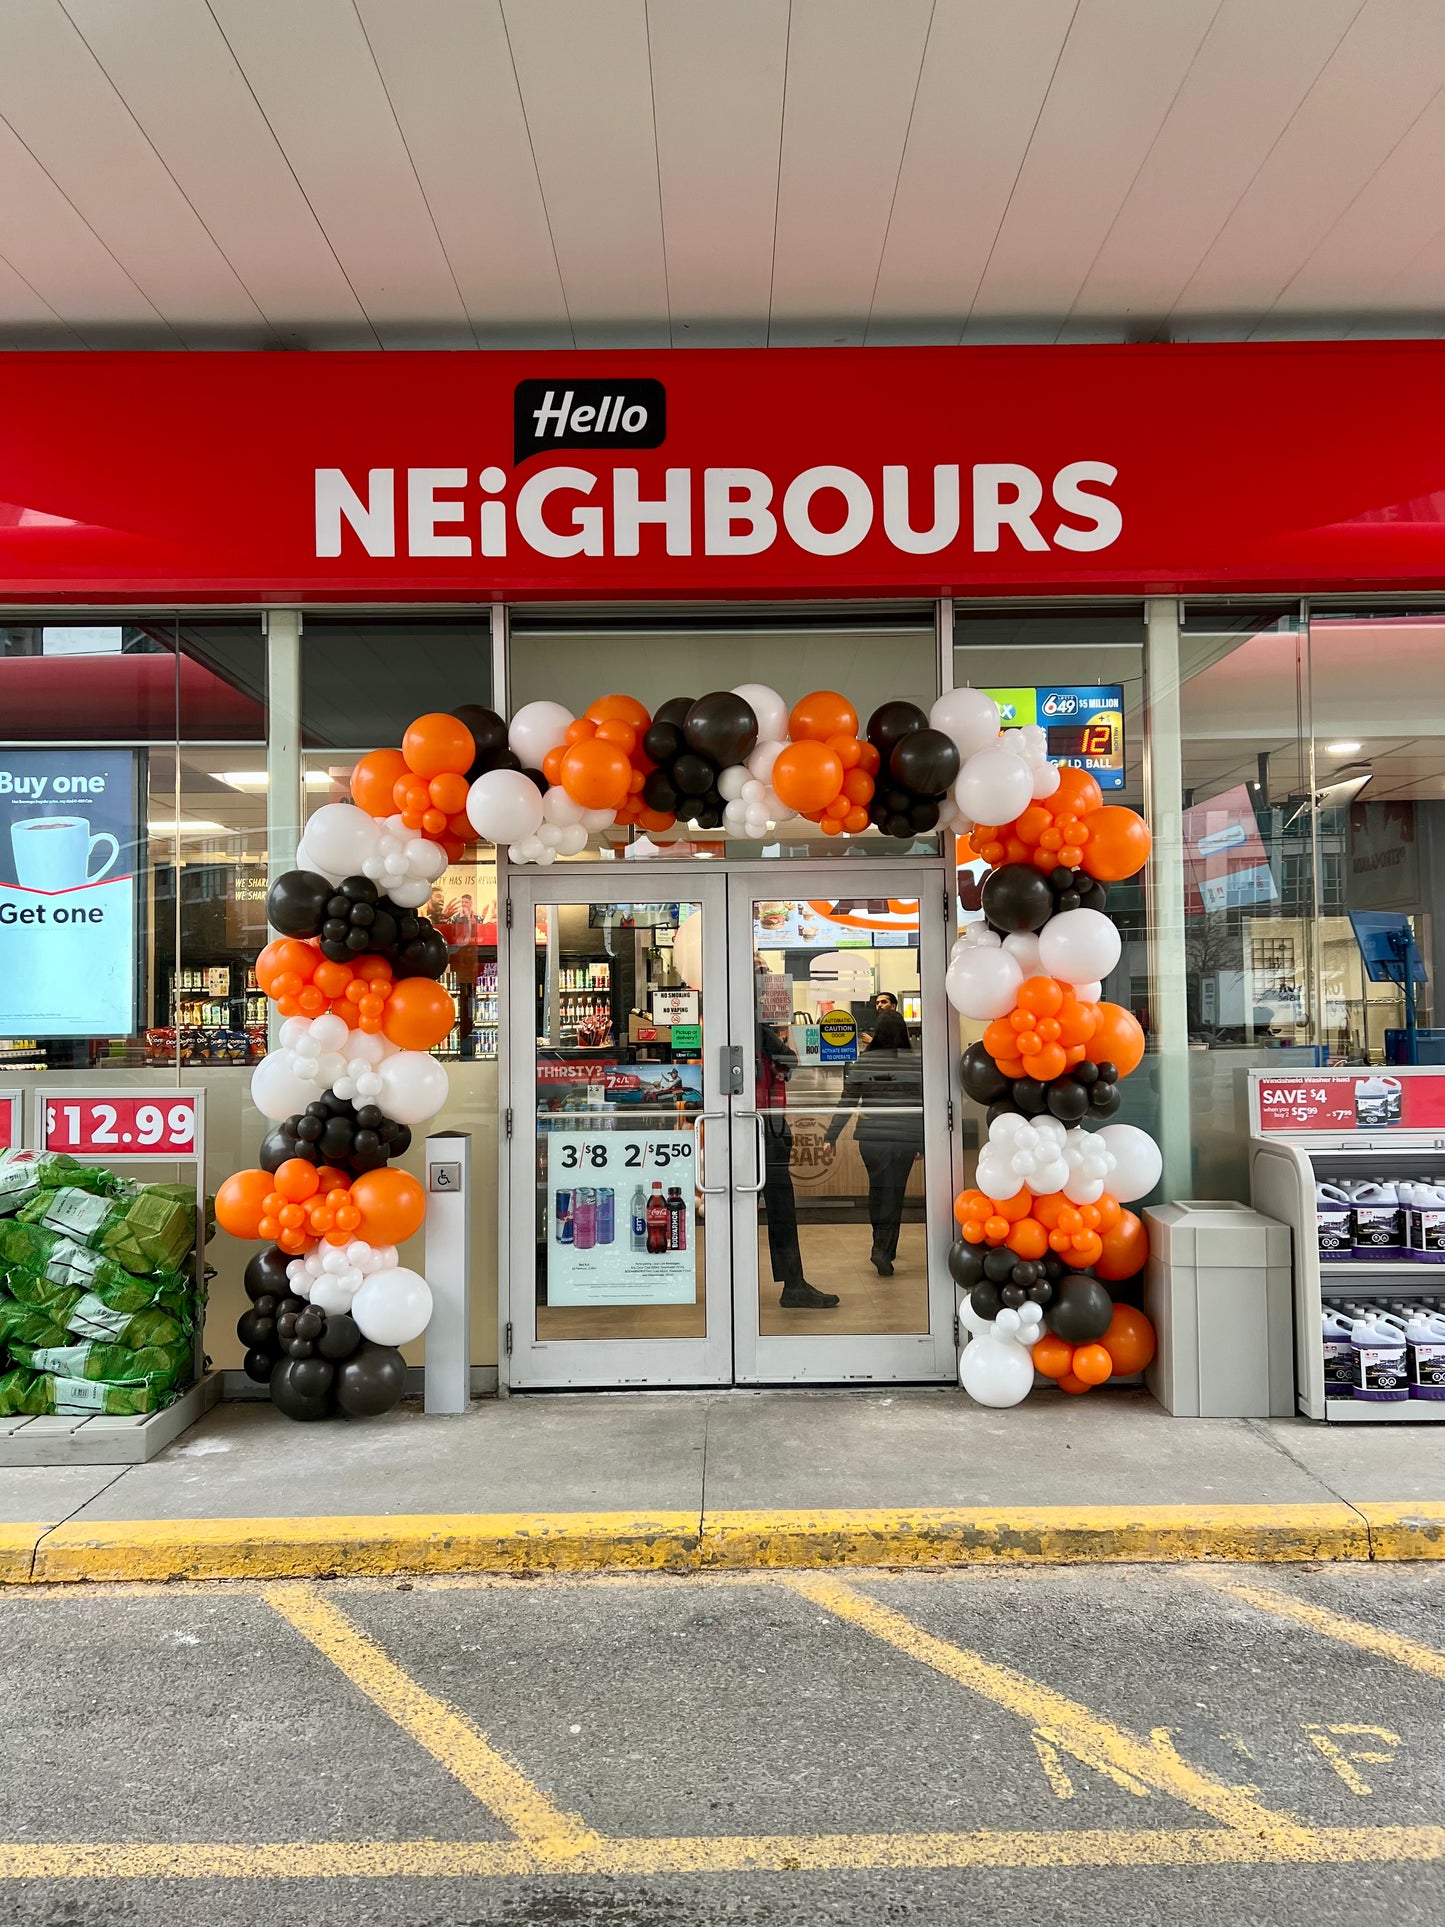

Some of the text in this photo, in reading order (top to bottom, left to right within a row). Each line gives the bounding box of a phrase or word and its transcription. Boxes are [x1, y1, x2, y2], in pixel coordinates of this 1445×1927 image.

[532, 391, 648, 437] Hello
[1079, 699, 1088, 708] $5
[1089, 698, 1119, 708] MILLION
[1081, 727, 1111, 753] 12
[1086, 758, 1112, 768] BALL
[0, 772, 48, 799] Buy
[235, 878, 246, 888] WE
[449, 876, 463, 885] HAS
[465, 876, 475, 885] ITS
[235, 890, 246, 900] WE
[0, 903, 46, 924] Get
[763, 1004, 777, 1012] INTO
[762, 1011, 789, 1019] BUILDING
[1262, 1088, 1328, 1104] SAVE $4
[791, 1133, 824, 1147] REW
[671, 1210, 679, 1249] BODYARMOR
